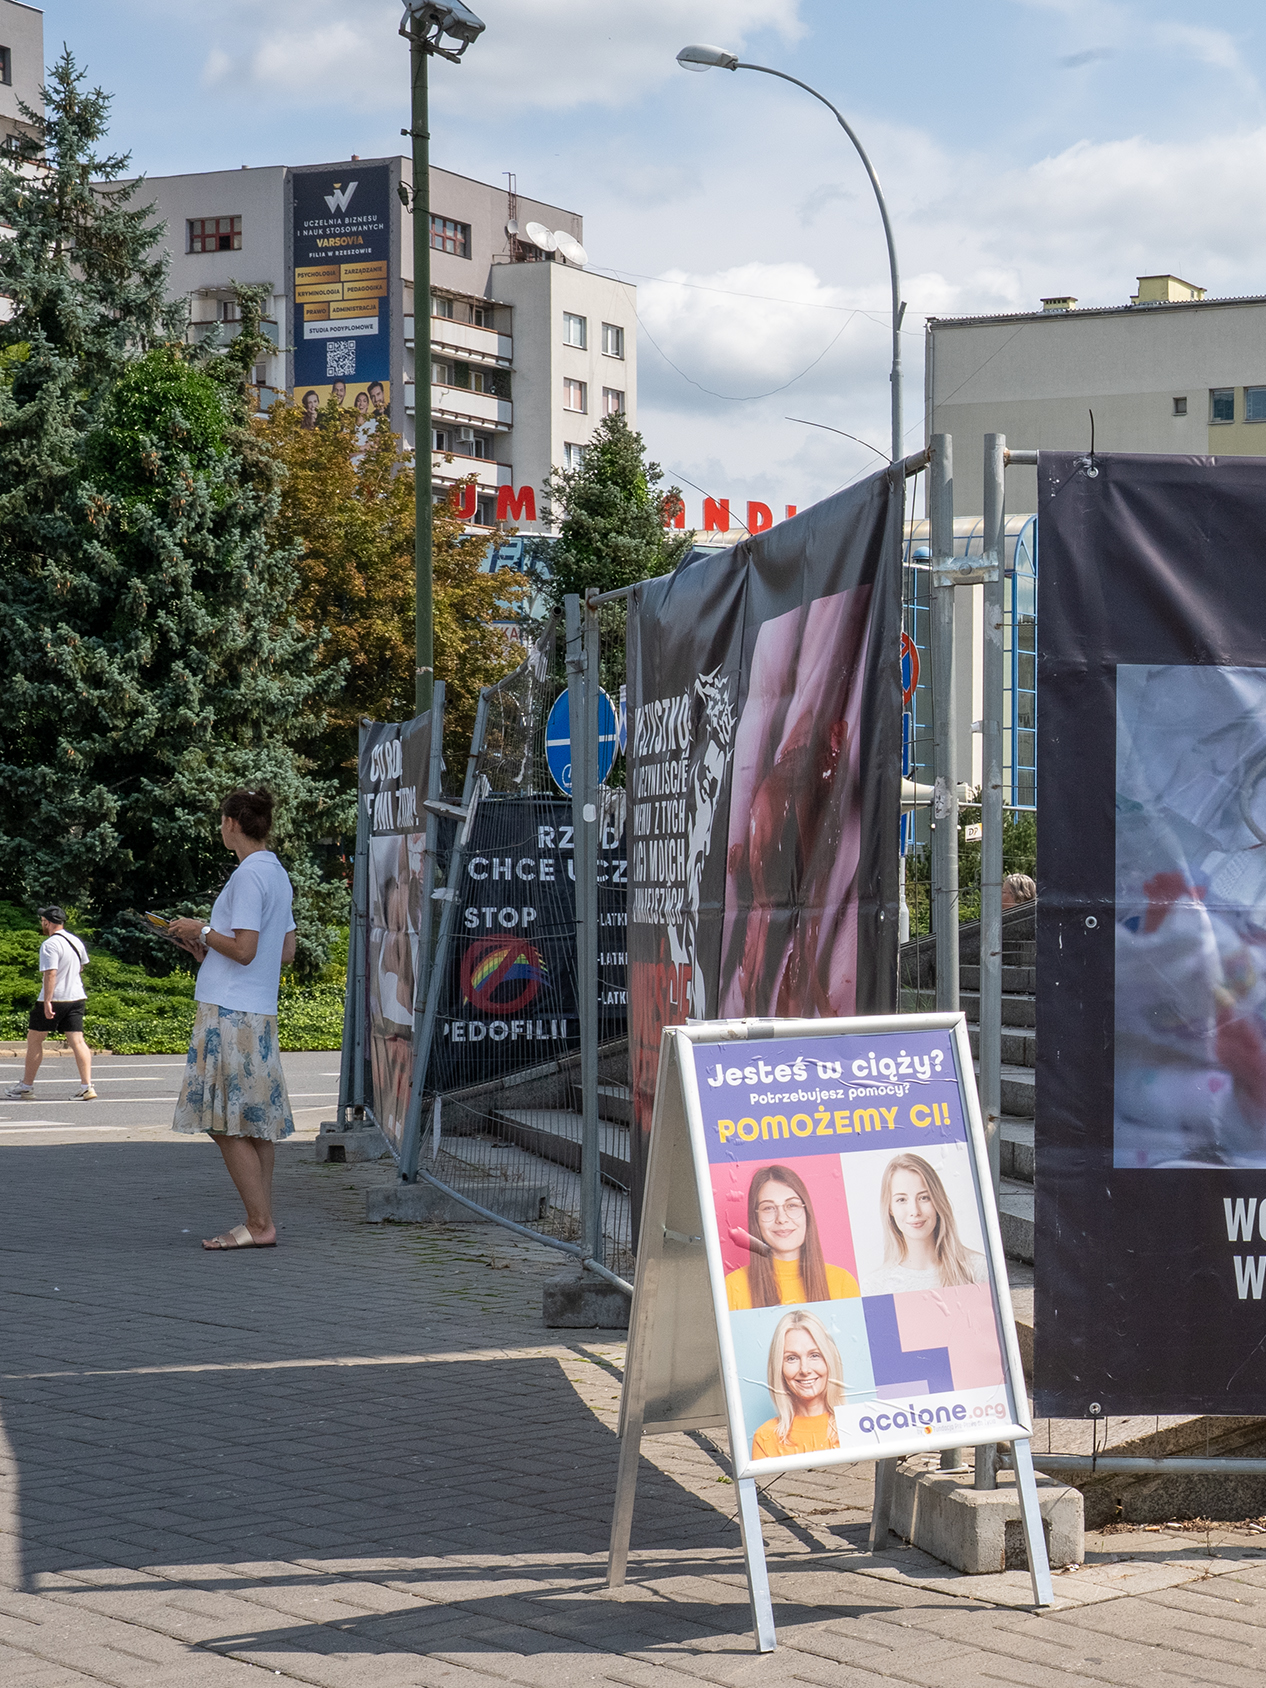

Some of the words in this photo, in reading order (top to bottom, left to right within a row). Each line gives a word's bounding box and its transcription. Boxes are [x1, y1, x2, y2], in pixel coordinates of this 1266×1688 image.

[303, 218, 342, 227] UCZELNIA
[344, 215, 378, 224] BIZNESU
[326, 223, 384, 235] STOSOWANYCH
[316, 235, 364, 248] VARSOVIA
[335, 248, 372, 256] RZESZOWIE
[297, 270, 336, 278] PSYCHOLOGIA
[344, 266, 382, 275] ZARZĄDZANIE
[297, 288, 340, 297] KRYMINOLOGIA
[347, 284, 383, 292] PEDAGOGIKA
[332, 304, 376, 313] ADMINISTRACJA
[309, 326, 329, 334] STUDIA
[329, 323, 374, 332] PODYPLOMOWE
[537, 825, 620, 850] RZD
[467, 857, 555, 881] CHCE
[464, 906, 538, 928] STOP
[707, 1056, 808, 1088] Jesteś
[816, 1059, 842, 1080] w
[851, 1048, 945, 1082] ciąży?
[750, 1087, 845, 1105] Potrzebujesz
[848, 1082, 911, 1101] pomocy?
[717, 1105, 899, 1143] POMOŻEMY
[910, 1102, 952, 1128] CI!
[859, 1402, 1007, 1434] ocalone.org
